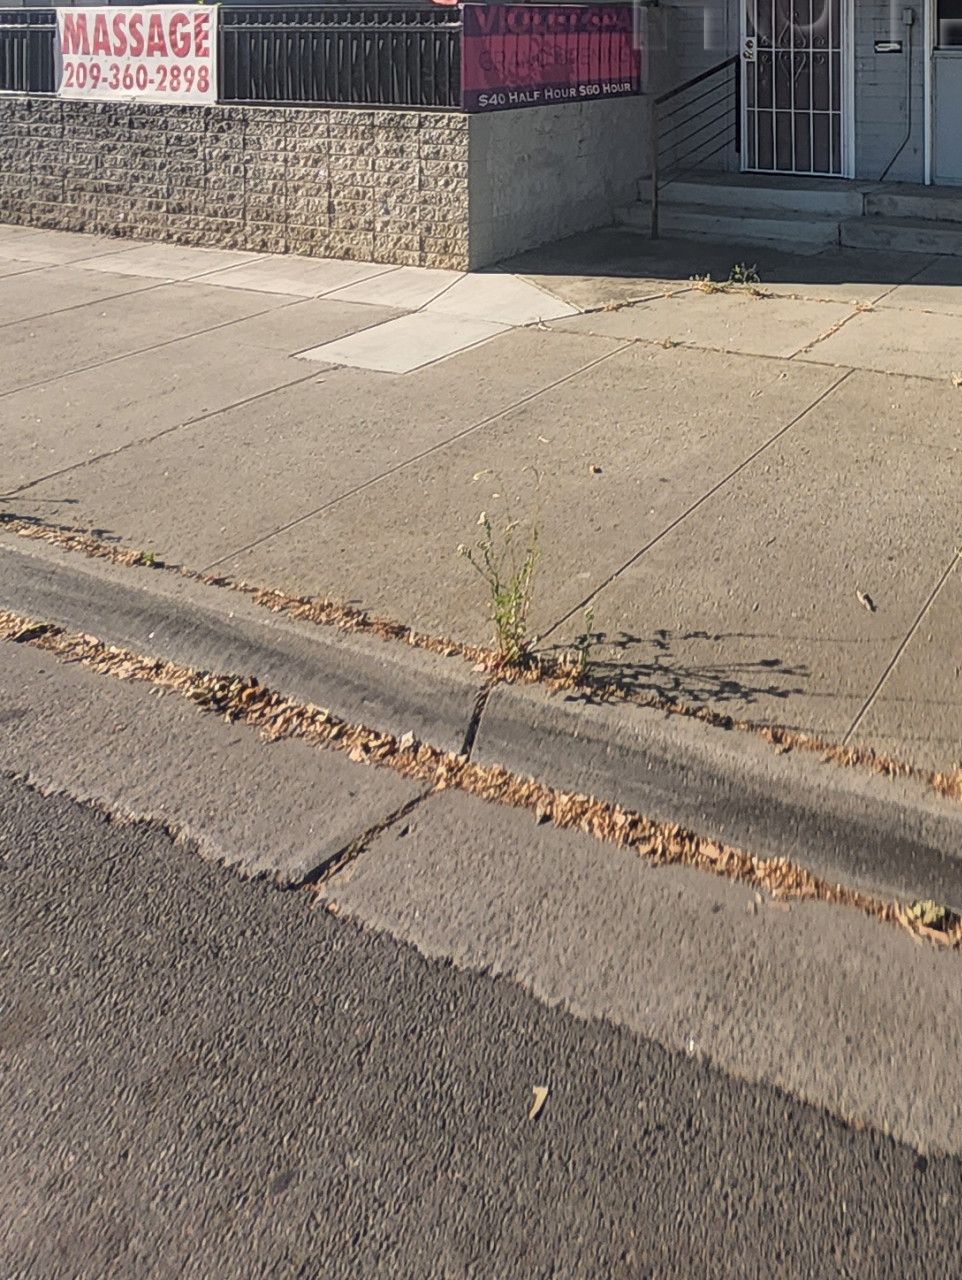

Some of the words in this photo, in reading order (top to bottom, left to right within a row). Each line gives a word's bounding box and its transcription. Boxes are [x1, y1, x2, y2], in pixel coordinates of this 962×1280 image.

[61, 13, 210, 58] MASSAGE
[64, 61, 210, 94] 209-360-2898
[478, 93, 506, 107] $40
[508, 90, 541, 104] HALF
[544, 87, 577, 100] HOUR
[579, 84, 600, 97] $60
[602, 82, 632, 94] HOUR
